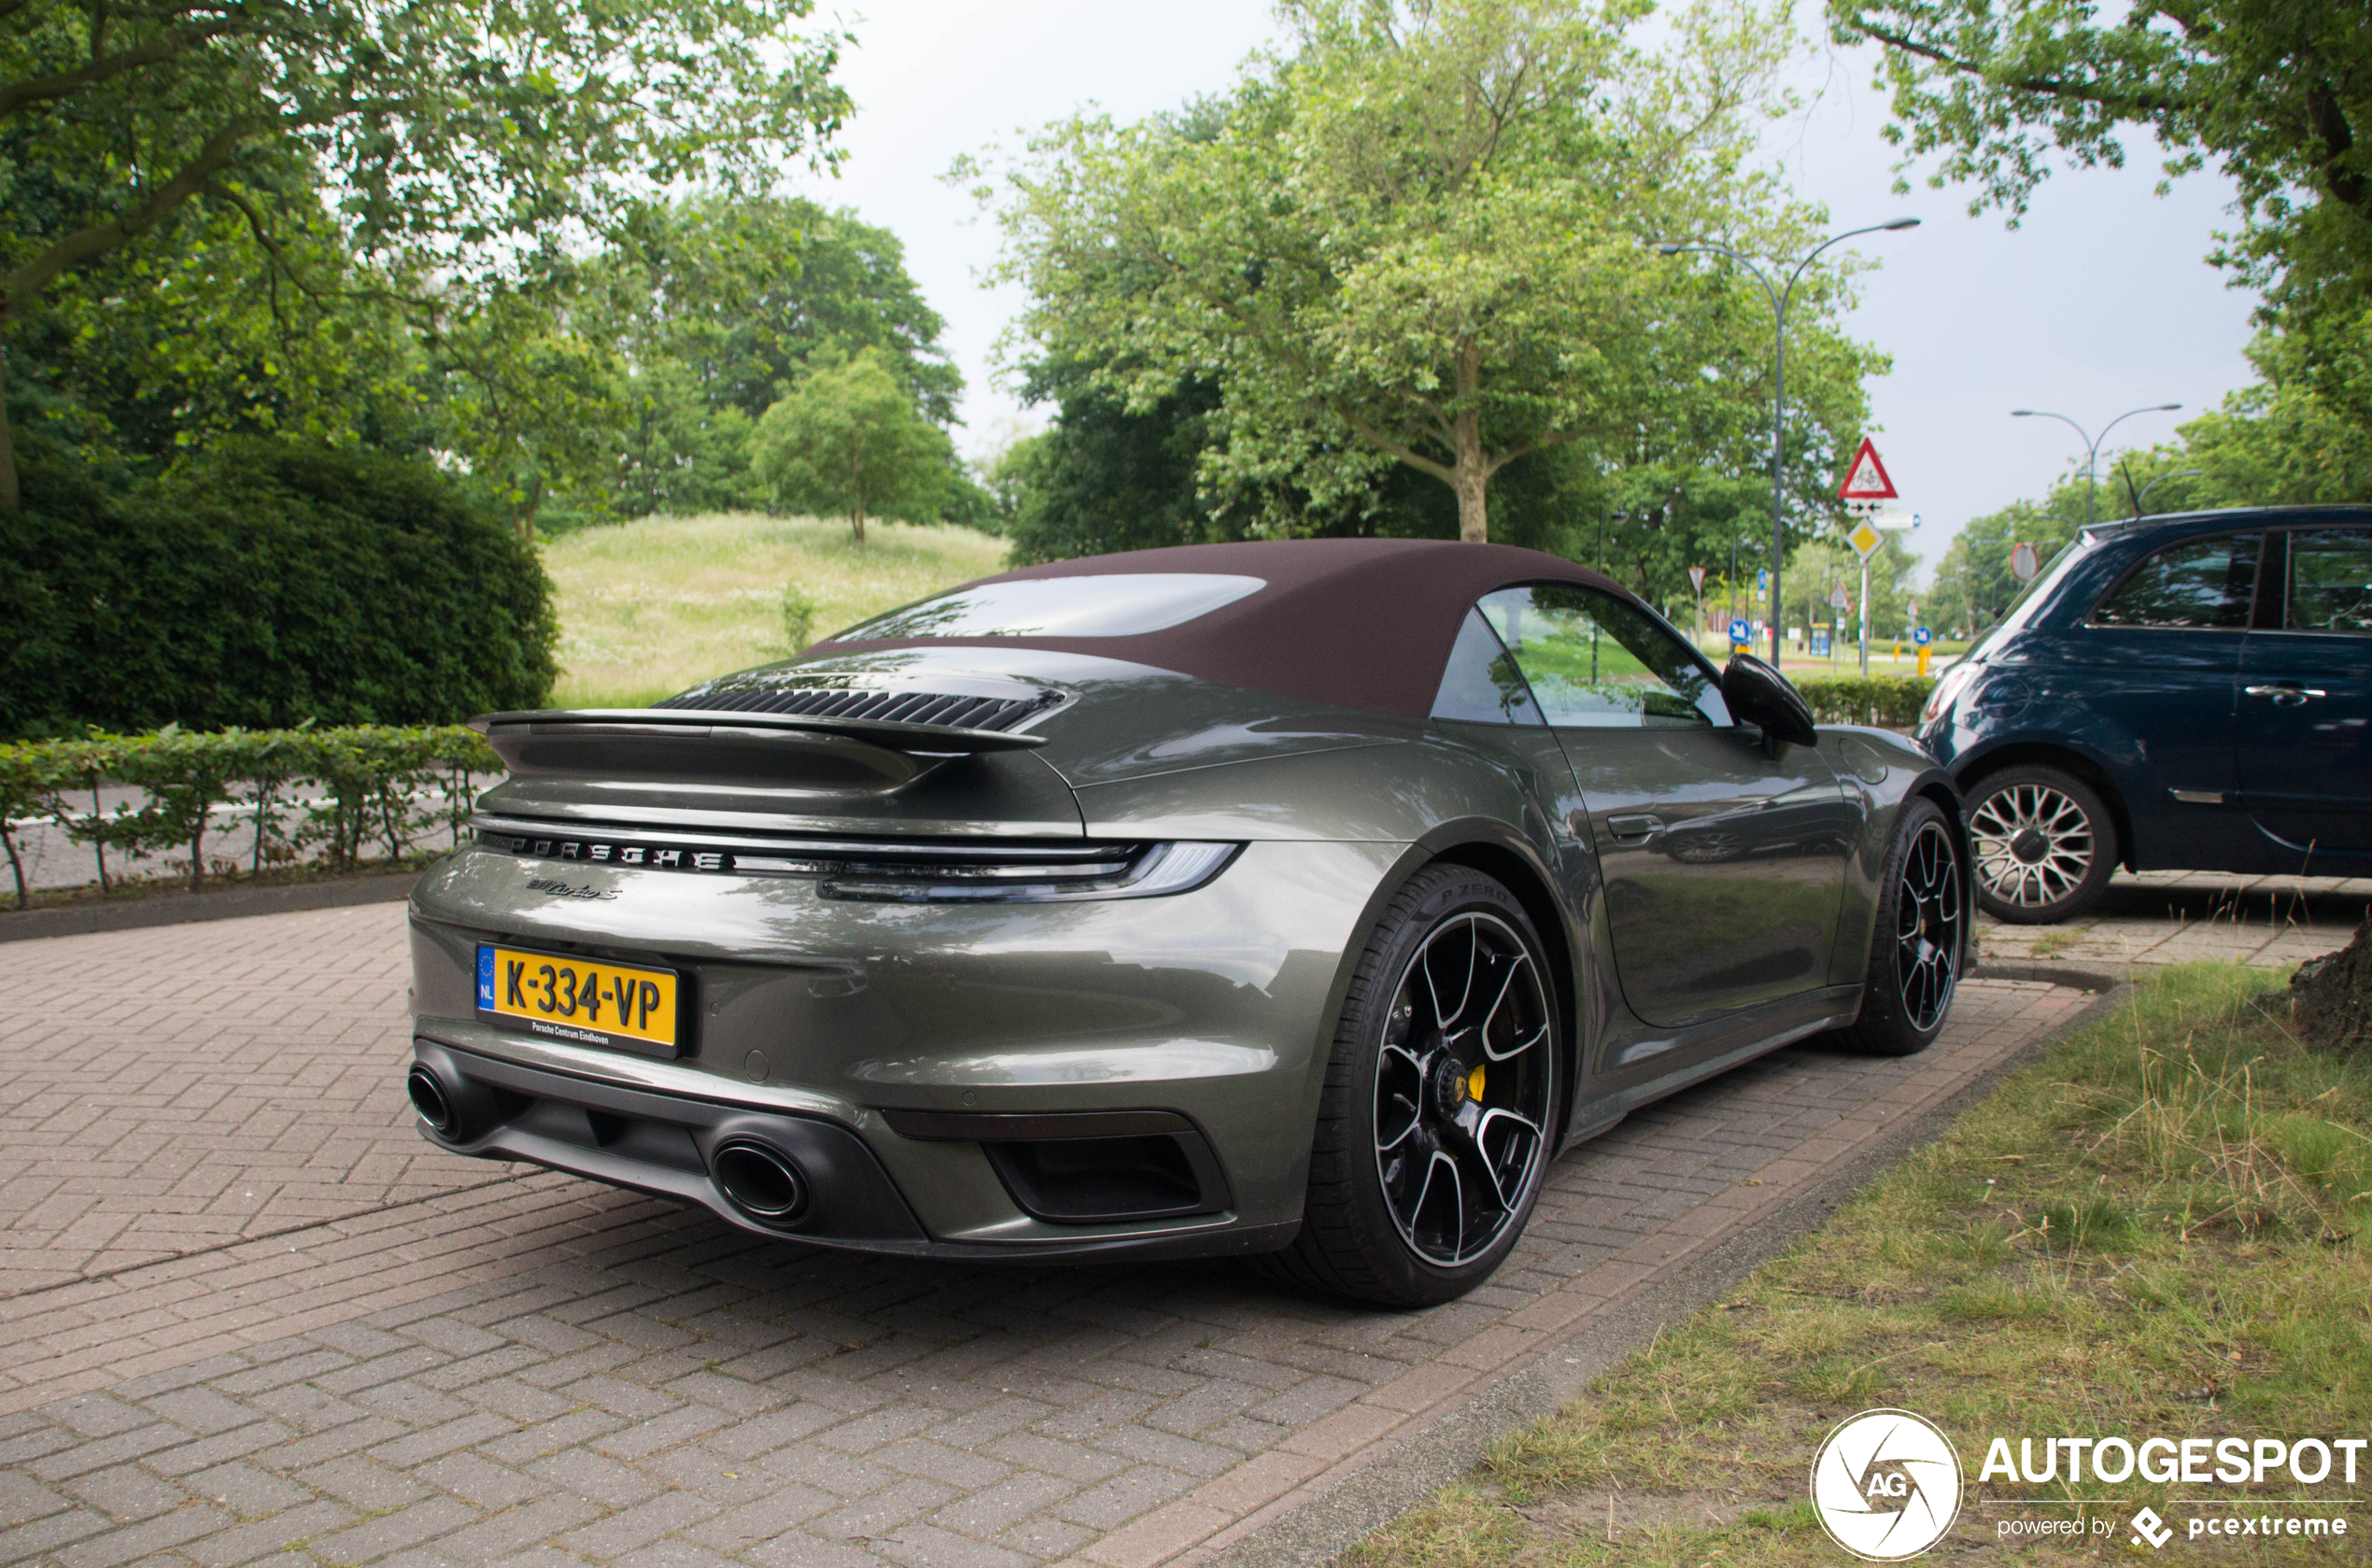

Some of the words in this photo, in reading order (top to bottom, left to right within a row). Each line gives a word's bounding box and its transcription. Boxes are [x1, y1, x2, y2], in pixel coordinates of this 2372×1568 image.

[511, 839, 726, 869] PORSCHE
[597, 890, 623, 899] S
[480, 983, 493, 1000] NL
[507, 959, 660, 1030] K-334-VP
[531, 1021, 555, 1035] Porsche
[554, 1025, 579, 1039] Centrum
[579, 1030, 609, 1045] Eindhoven
